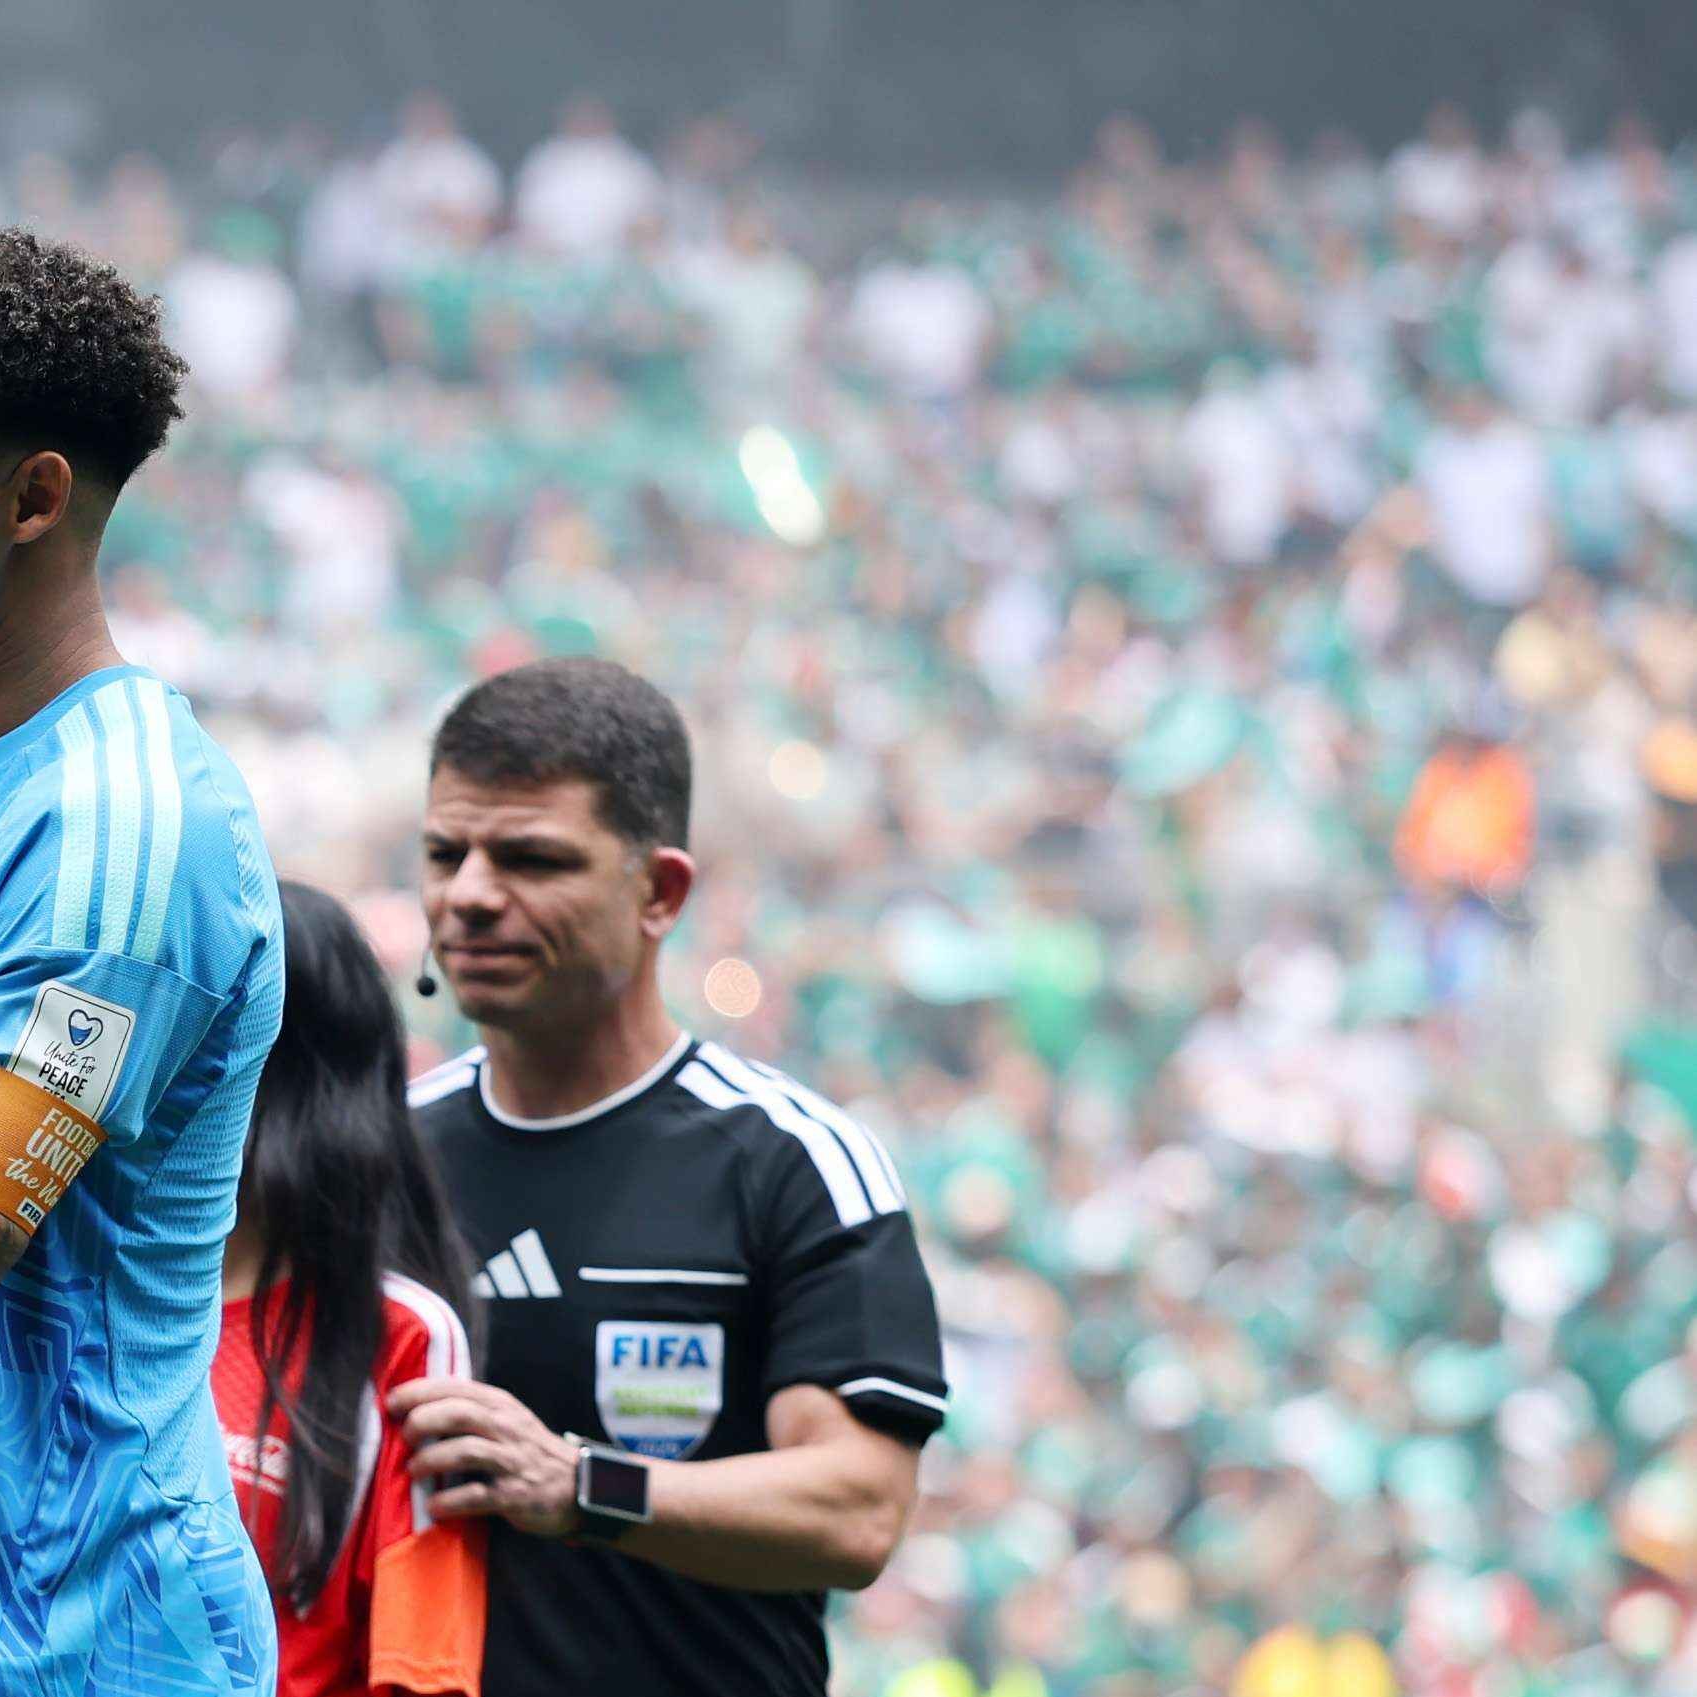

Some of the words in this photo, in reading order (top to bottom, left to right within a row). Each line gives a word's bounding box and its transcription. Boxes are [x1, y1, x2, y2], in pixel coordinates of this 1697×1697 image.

[44, 1040, 78, 1068] Unite
[38, 1061, 88, 1098] PEACE
[5, 1157, 41, 1189] the
[611, 1333, 709, 1369] FIFA
